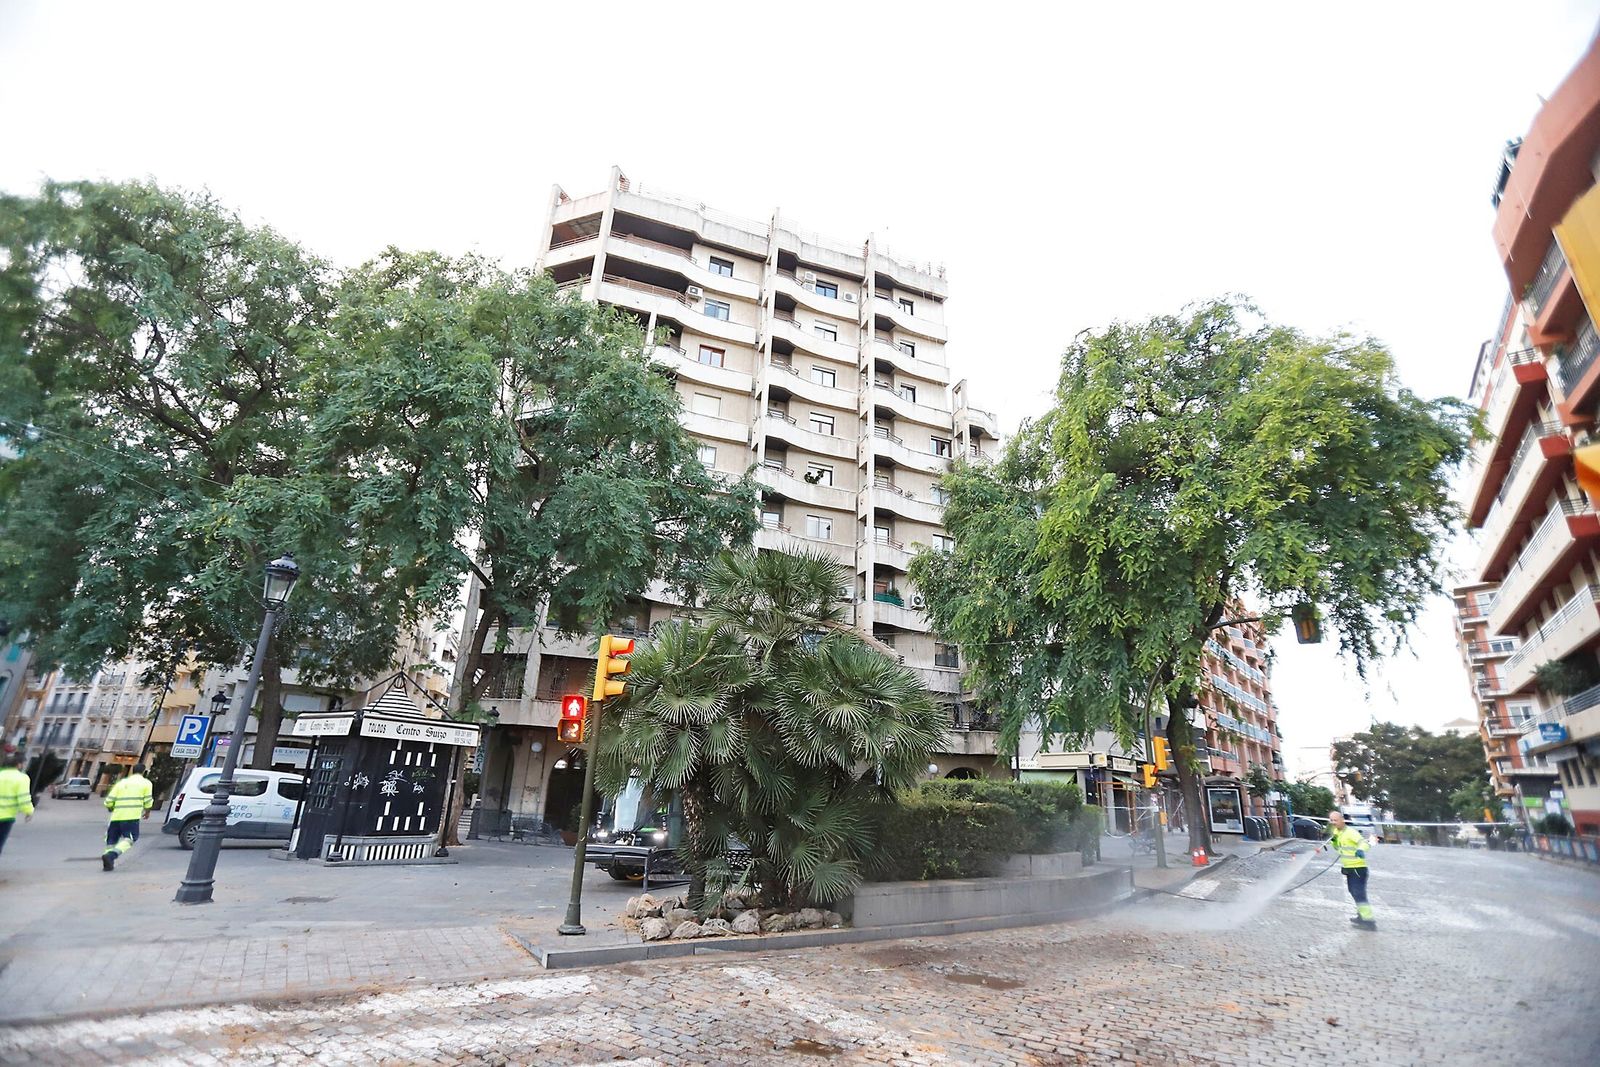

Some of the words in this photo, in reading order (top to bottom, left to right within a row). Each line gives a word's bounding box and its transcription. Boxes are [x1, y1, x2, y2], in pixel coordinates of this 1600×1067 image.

[180, 718, 202, 741] P
[368, 722, 387, 734] TOLDOS
[396, 723, 420, 737] Centro
